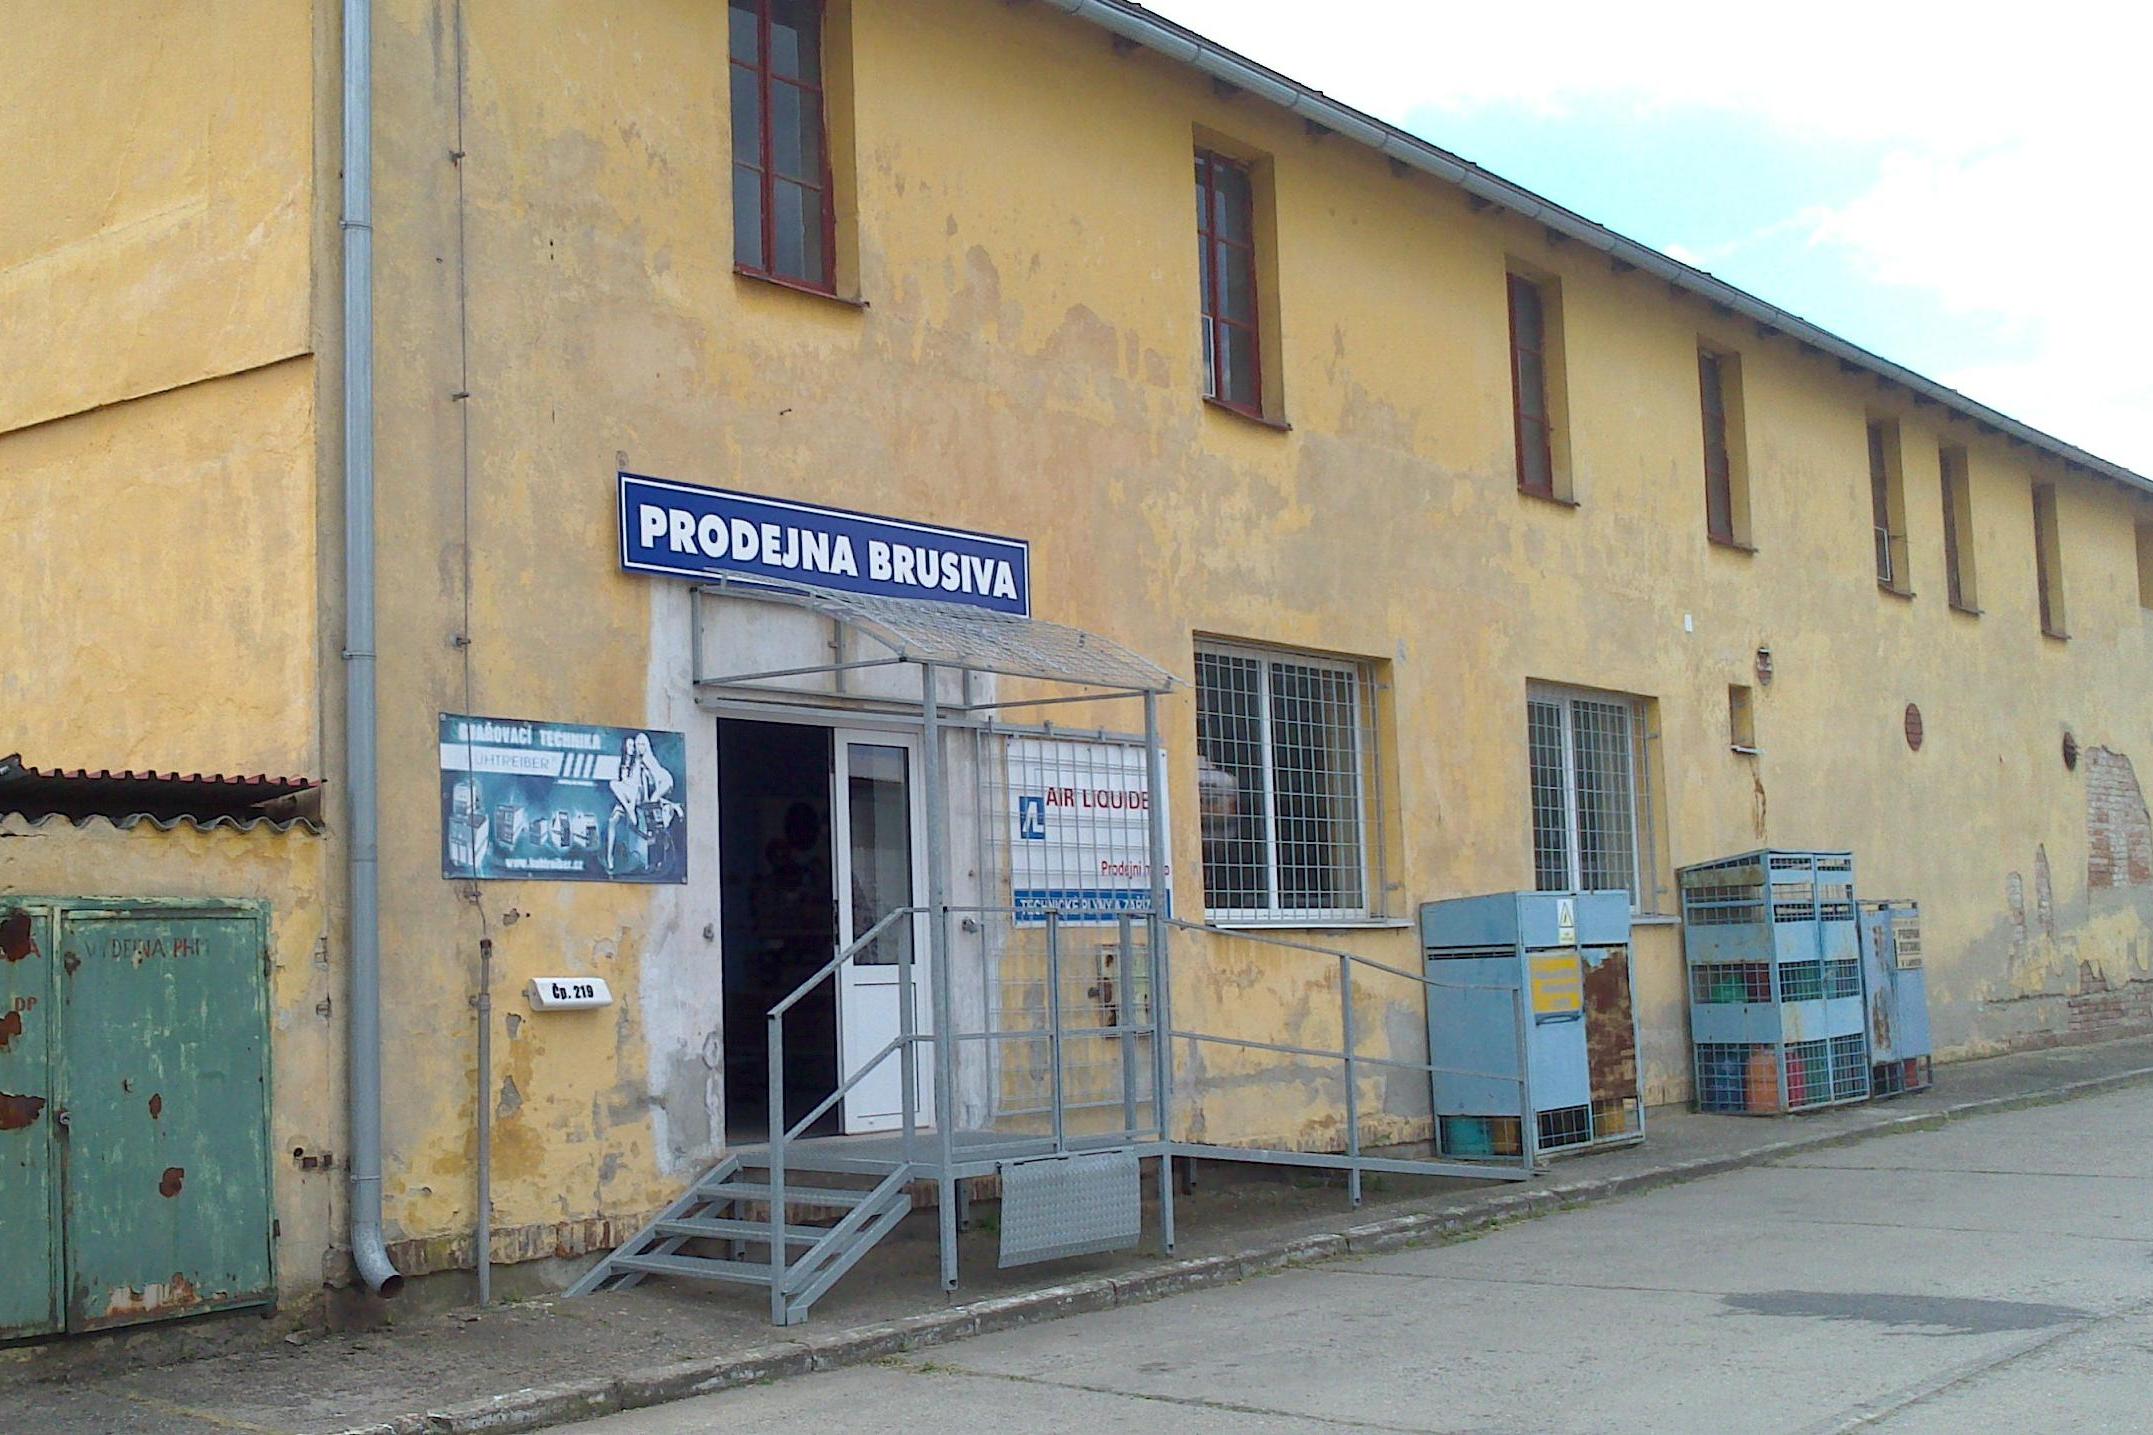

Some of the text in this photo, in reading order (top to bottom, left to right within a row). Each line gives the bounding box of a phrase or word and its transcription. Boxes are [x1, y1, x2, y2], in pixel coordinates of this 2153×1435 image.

[639, 504, 1018, 600] PRODEJNA BRUSIVA
[1046, 787, 1150, 810] AIR LIQUIDE
[573, 984, 594, 999] 219
